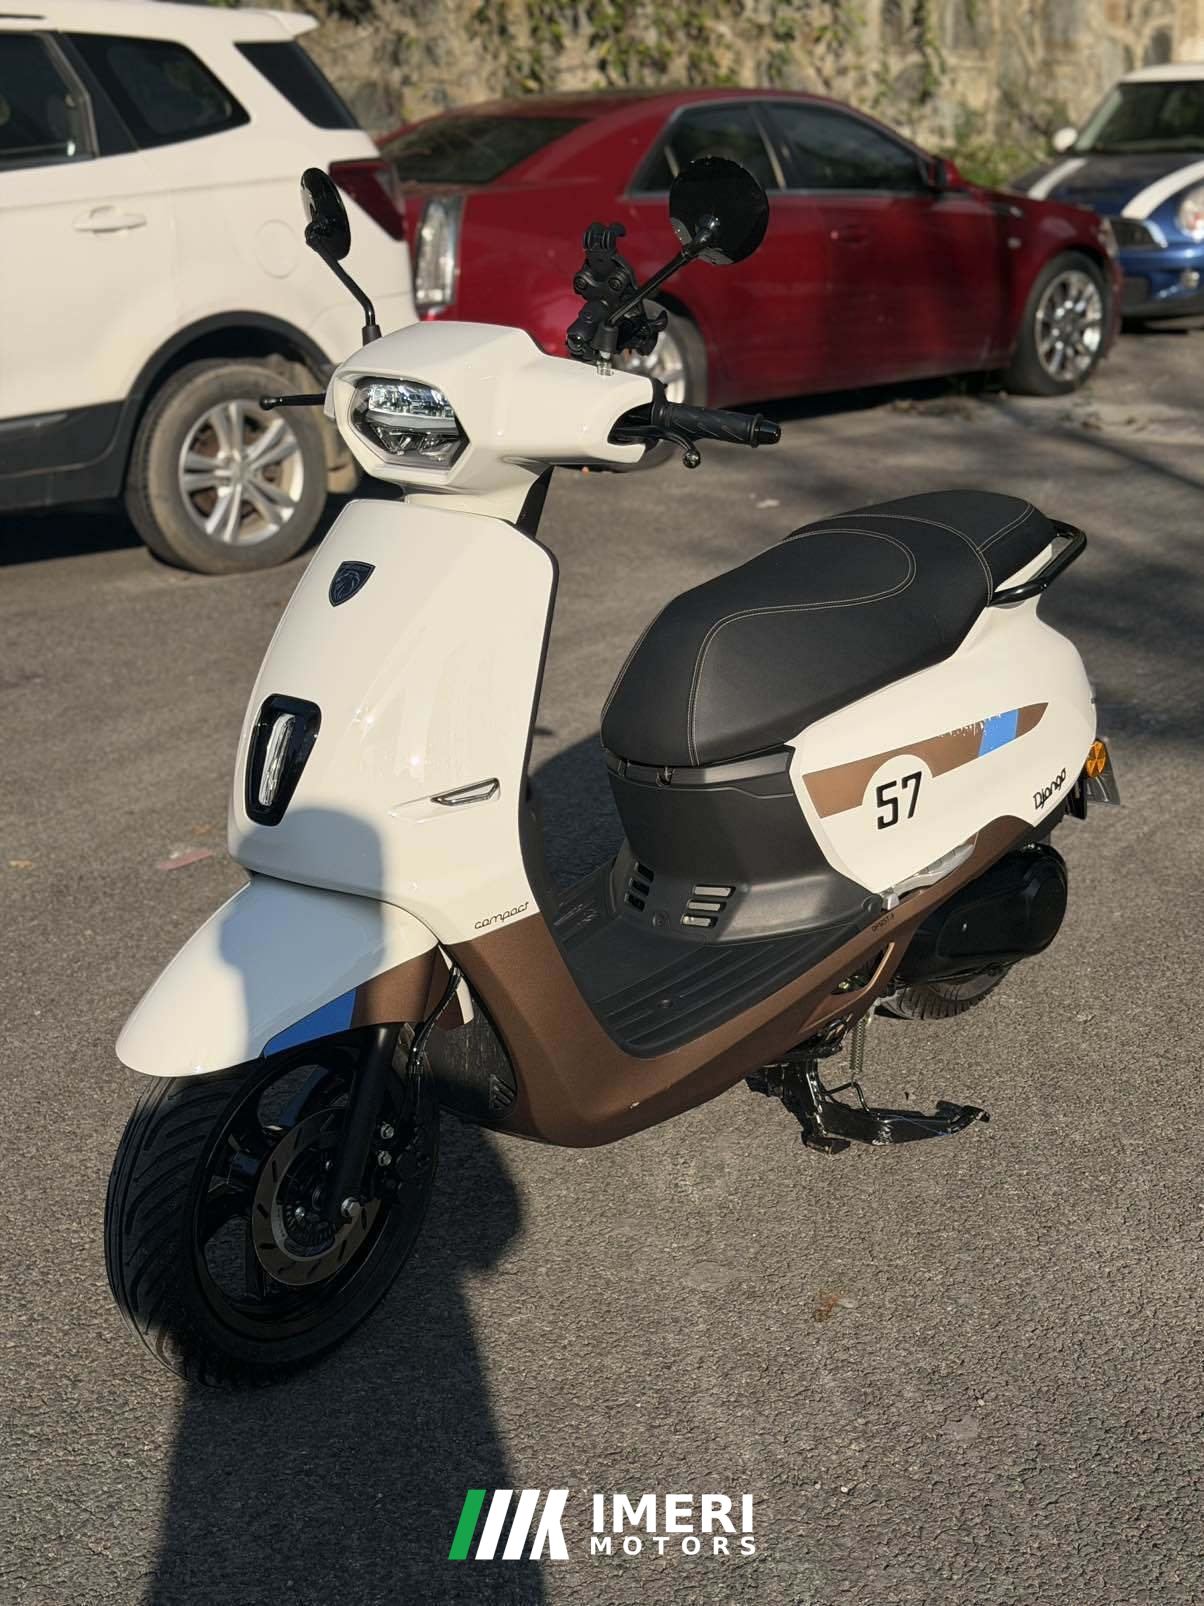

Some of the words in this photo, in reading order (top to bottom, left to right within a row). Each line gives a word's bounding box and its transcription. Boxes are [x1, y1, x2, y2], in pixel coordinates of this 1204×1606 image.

[876, 770, 922, 830] 57
[1033, 767, 1066, 810] Django
[474, 901, 529, 930] compact
